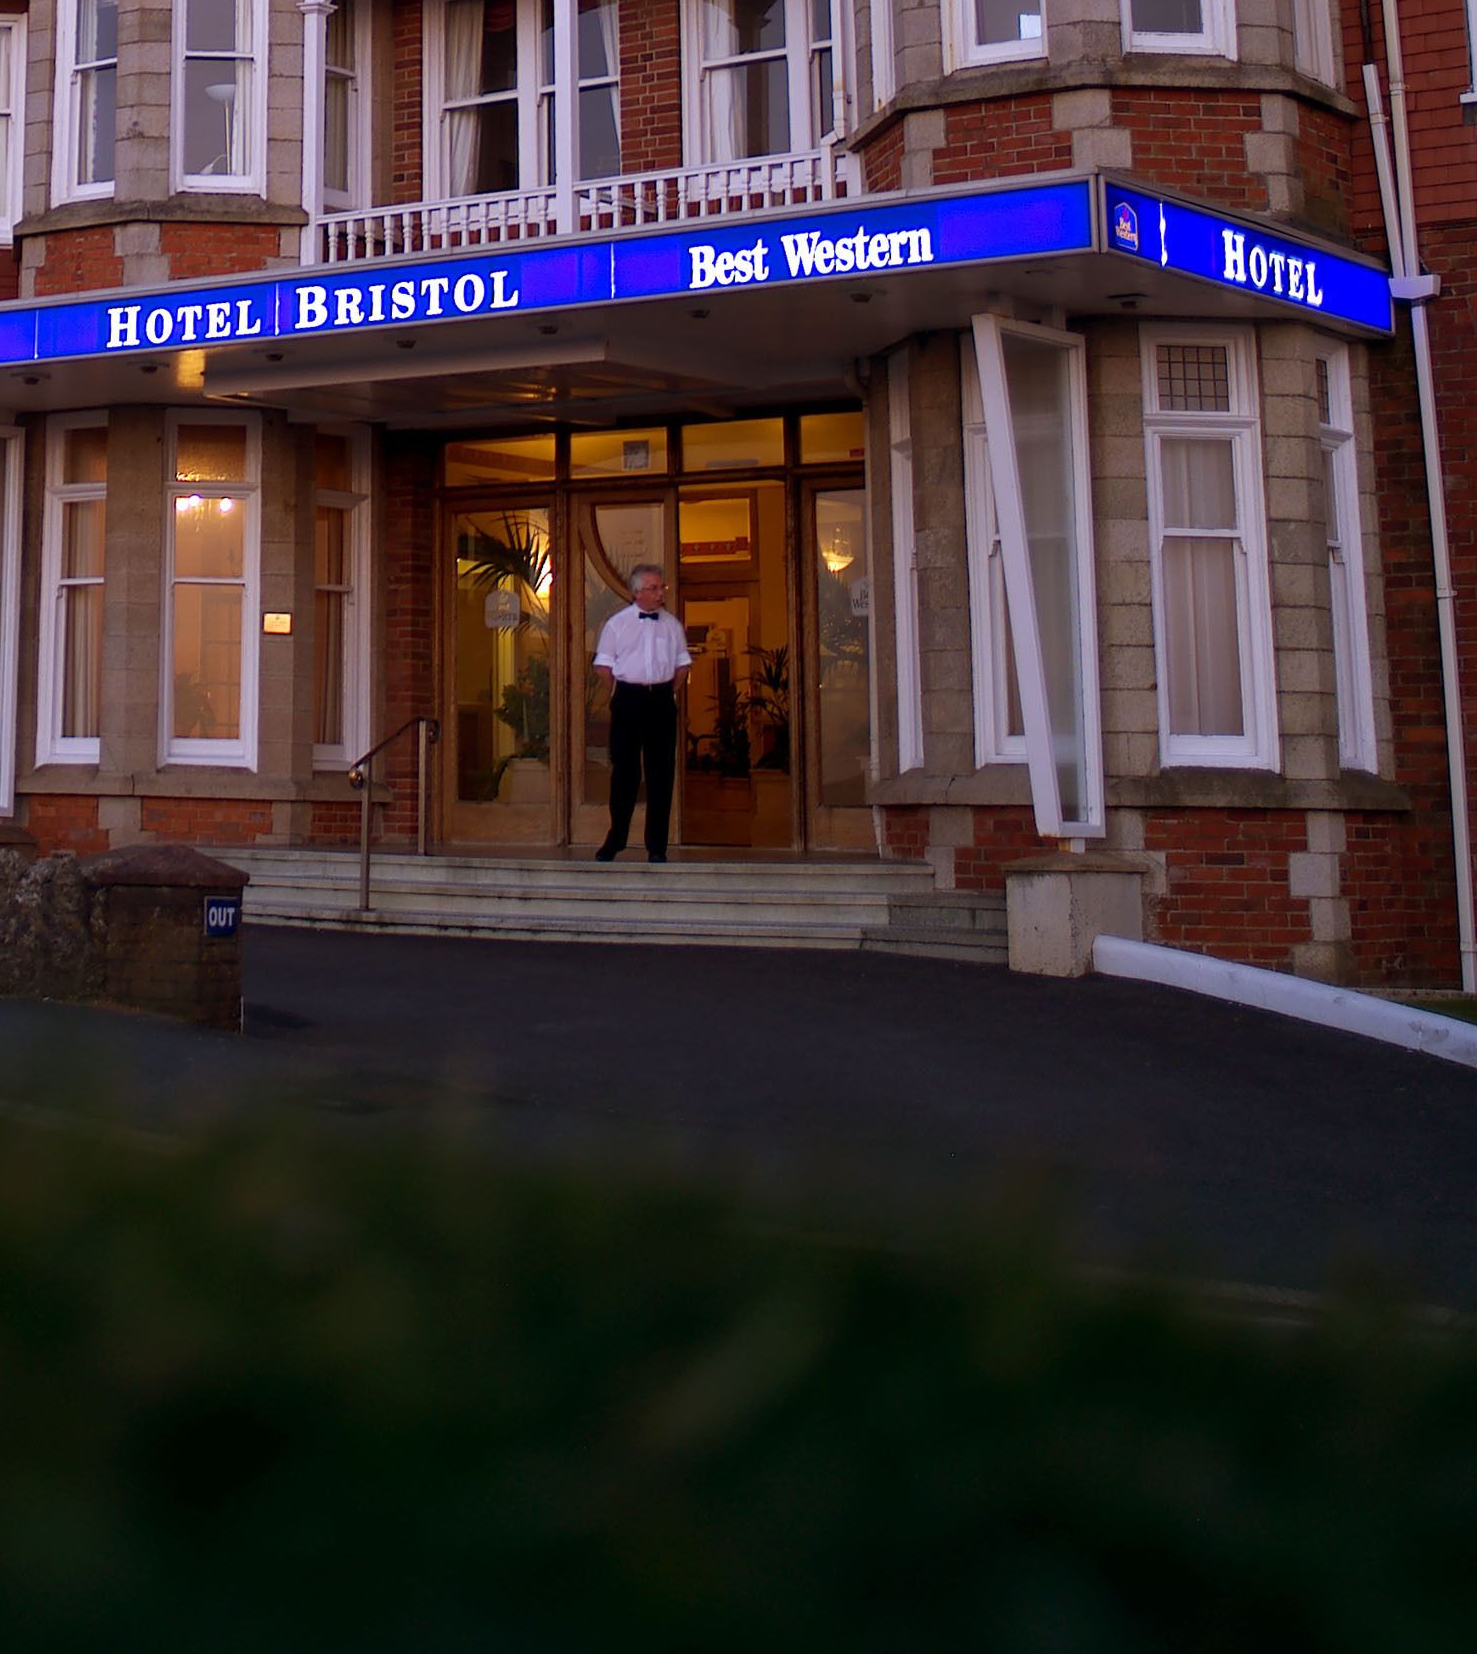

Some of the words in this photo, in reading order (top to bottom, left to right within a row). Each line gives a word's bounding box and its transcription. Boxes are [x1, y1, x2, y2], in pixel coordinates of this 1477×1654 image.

[689, 238, 769, 289] Best
[780, 226, 934, 277] Western
[1222, 228, 1323, 307] HOTEL
[106, 299, 261, 348] HOTEL
[294, 270, 519, 329] BRISTOL
[208, 907, 236, 927] OUT
